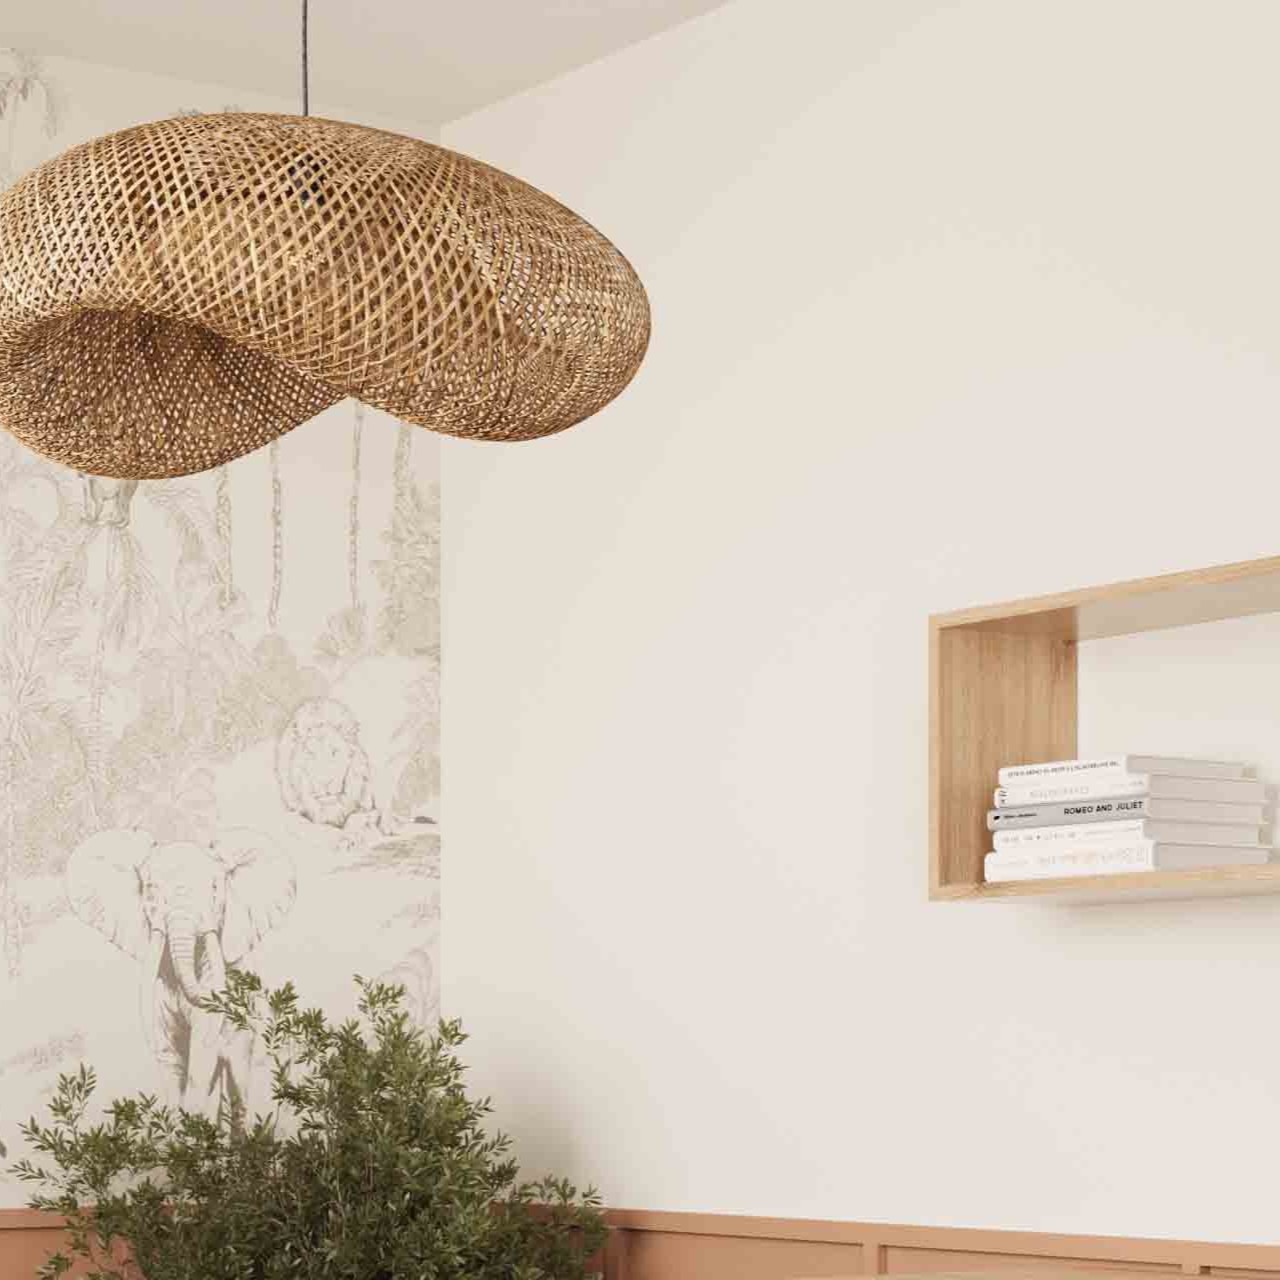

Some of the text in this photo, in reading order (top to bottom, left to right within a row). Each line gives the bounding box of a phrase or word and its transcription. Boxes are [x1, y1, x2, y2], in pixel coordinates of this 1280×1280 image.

[1063, 800, 1144, 815] ROMEO AND JULIET
